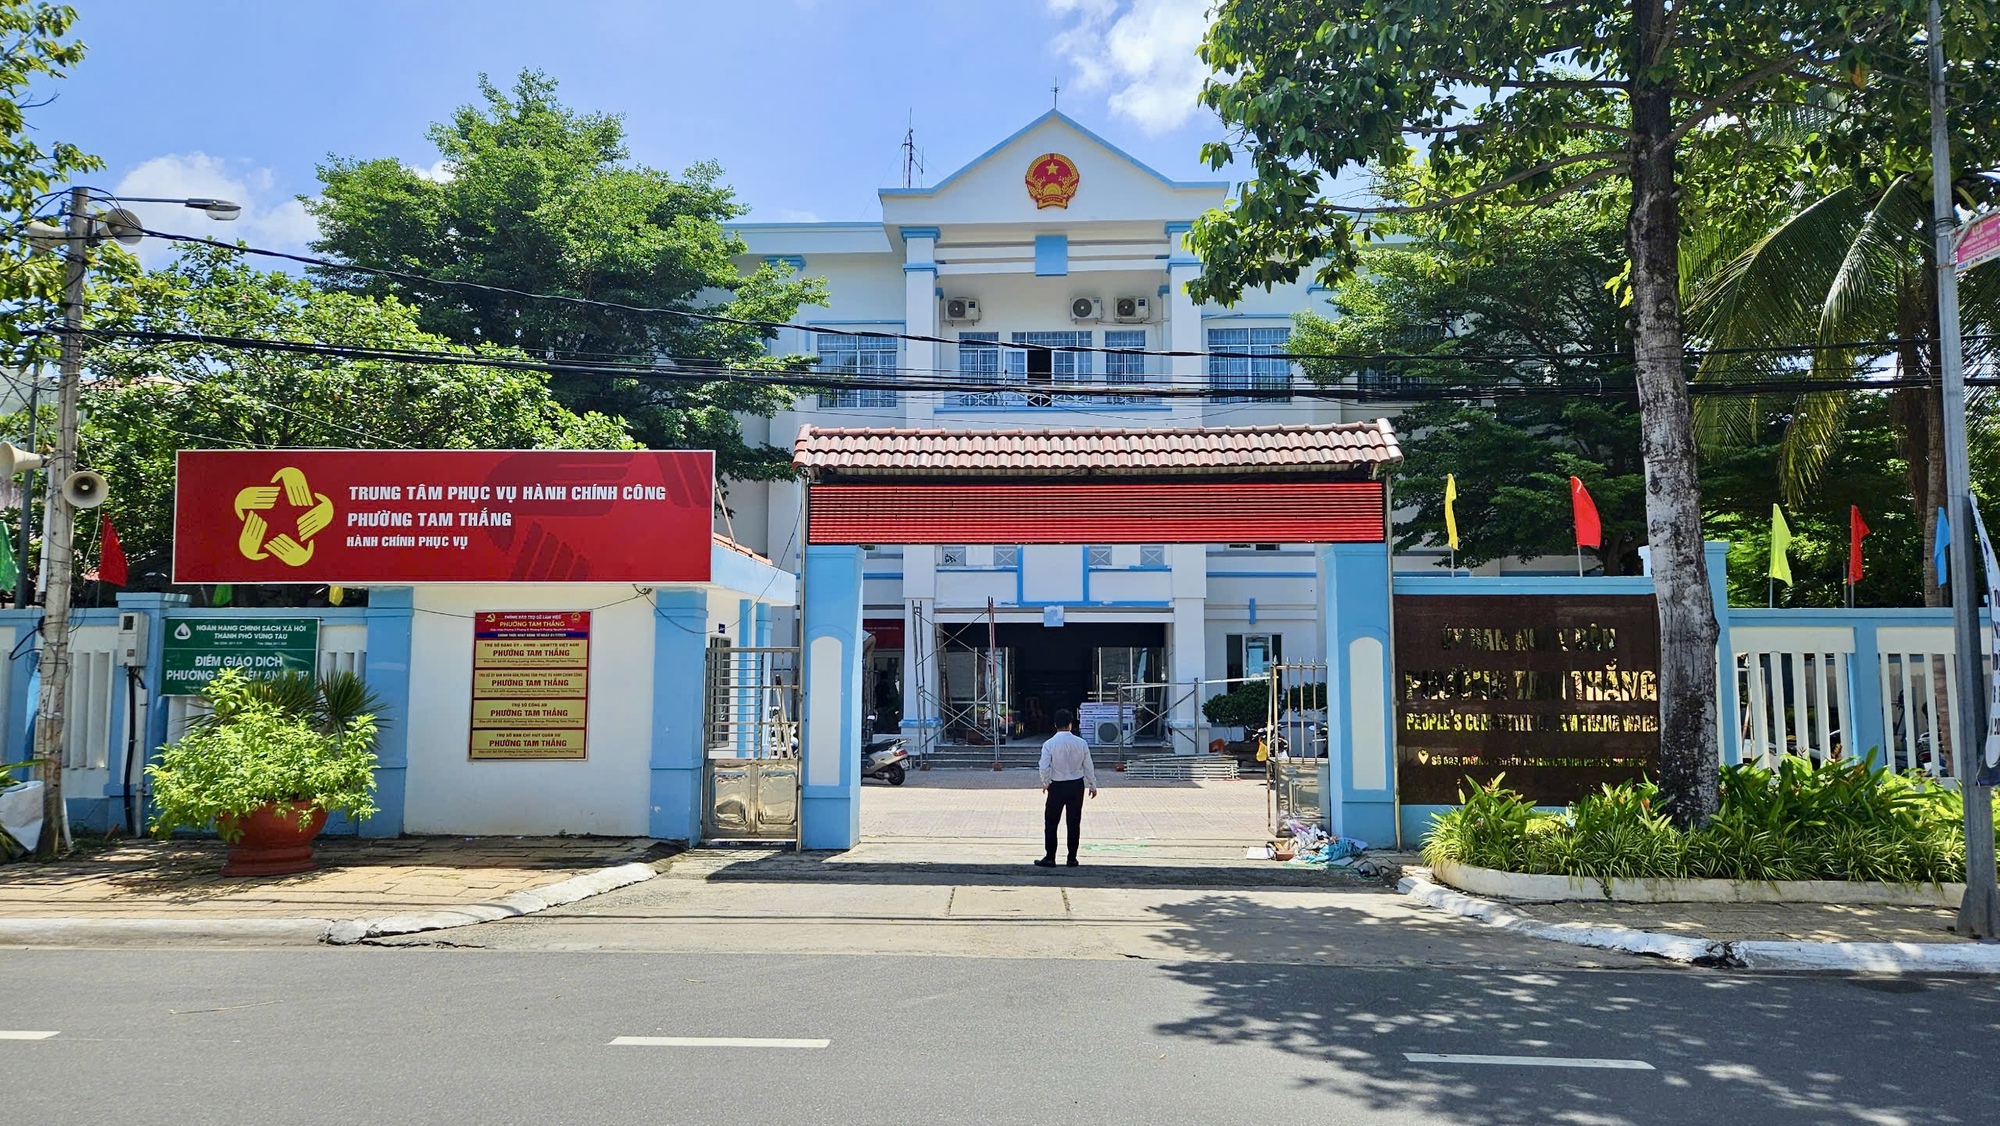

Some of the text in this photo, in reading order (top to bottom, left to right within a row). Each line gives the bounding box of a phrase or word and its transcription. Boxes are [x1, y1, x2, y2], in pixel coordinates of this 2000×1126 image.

[349, 484, 666, 503] TRUNG TÂM PHỤC VỤ HÀNH CHÍNH CÔNG
[347, 507, 512, 527] PHƯỜNG TAM THẮNG
[346, 534, 468, 550] HÀNH CHÍNH PHỤC VỤ
[493, 647, 570, 657] PHƯỜNG TAM THẮNG
[223, 655, 252, 667] GIAO
[491, 677, 569, 687] PHƯỜNG TAM THẮNG
[1570, 657, 1658, 701] THẮNG
[490, 707, 568, 717] PHƯỜNG TAM THẮNG
[1406, 709, 1462, 732] PEOPLE'S
[489, 737, 567, 747] PHƯỜNG TAM THẮNG
